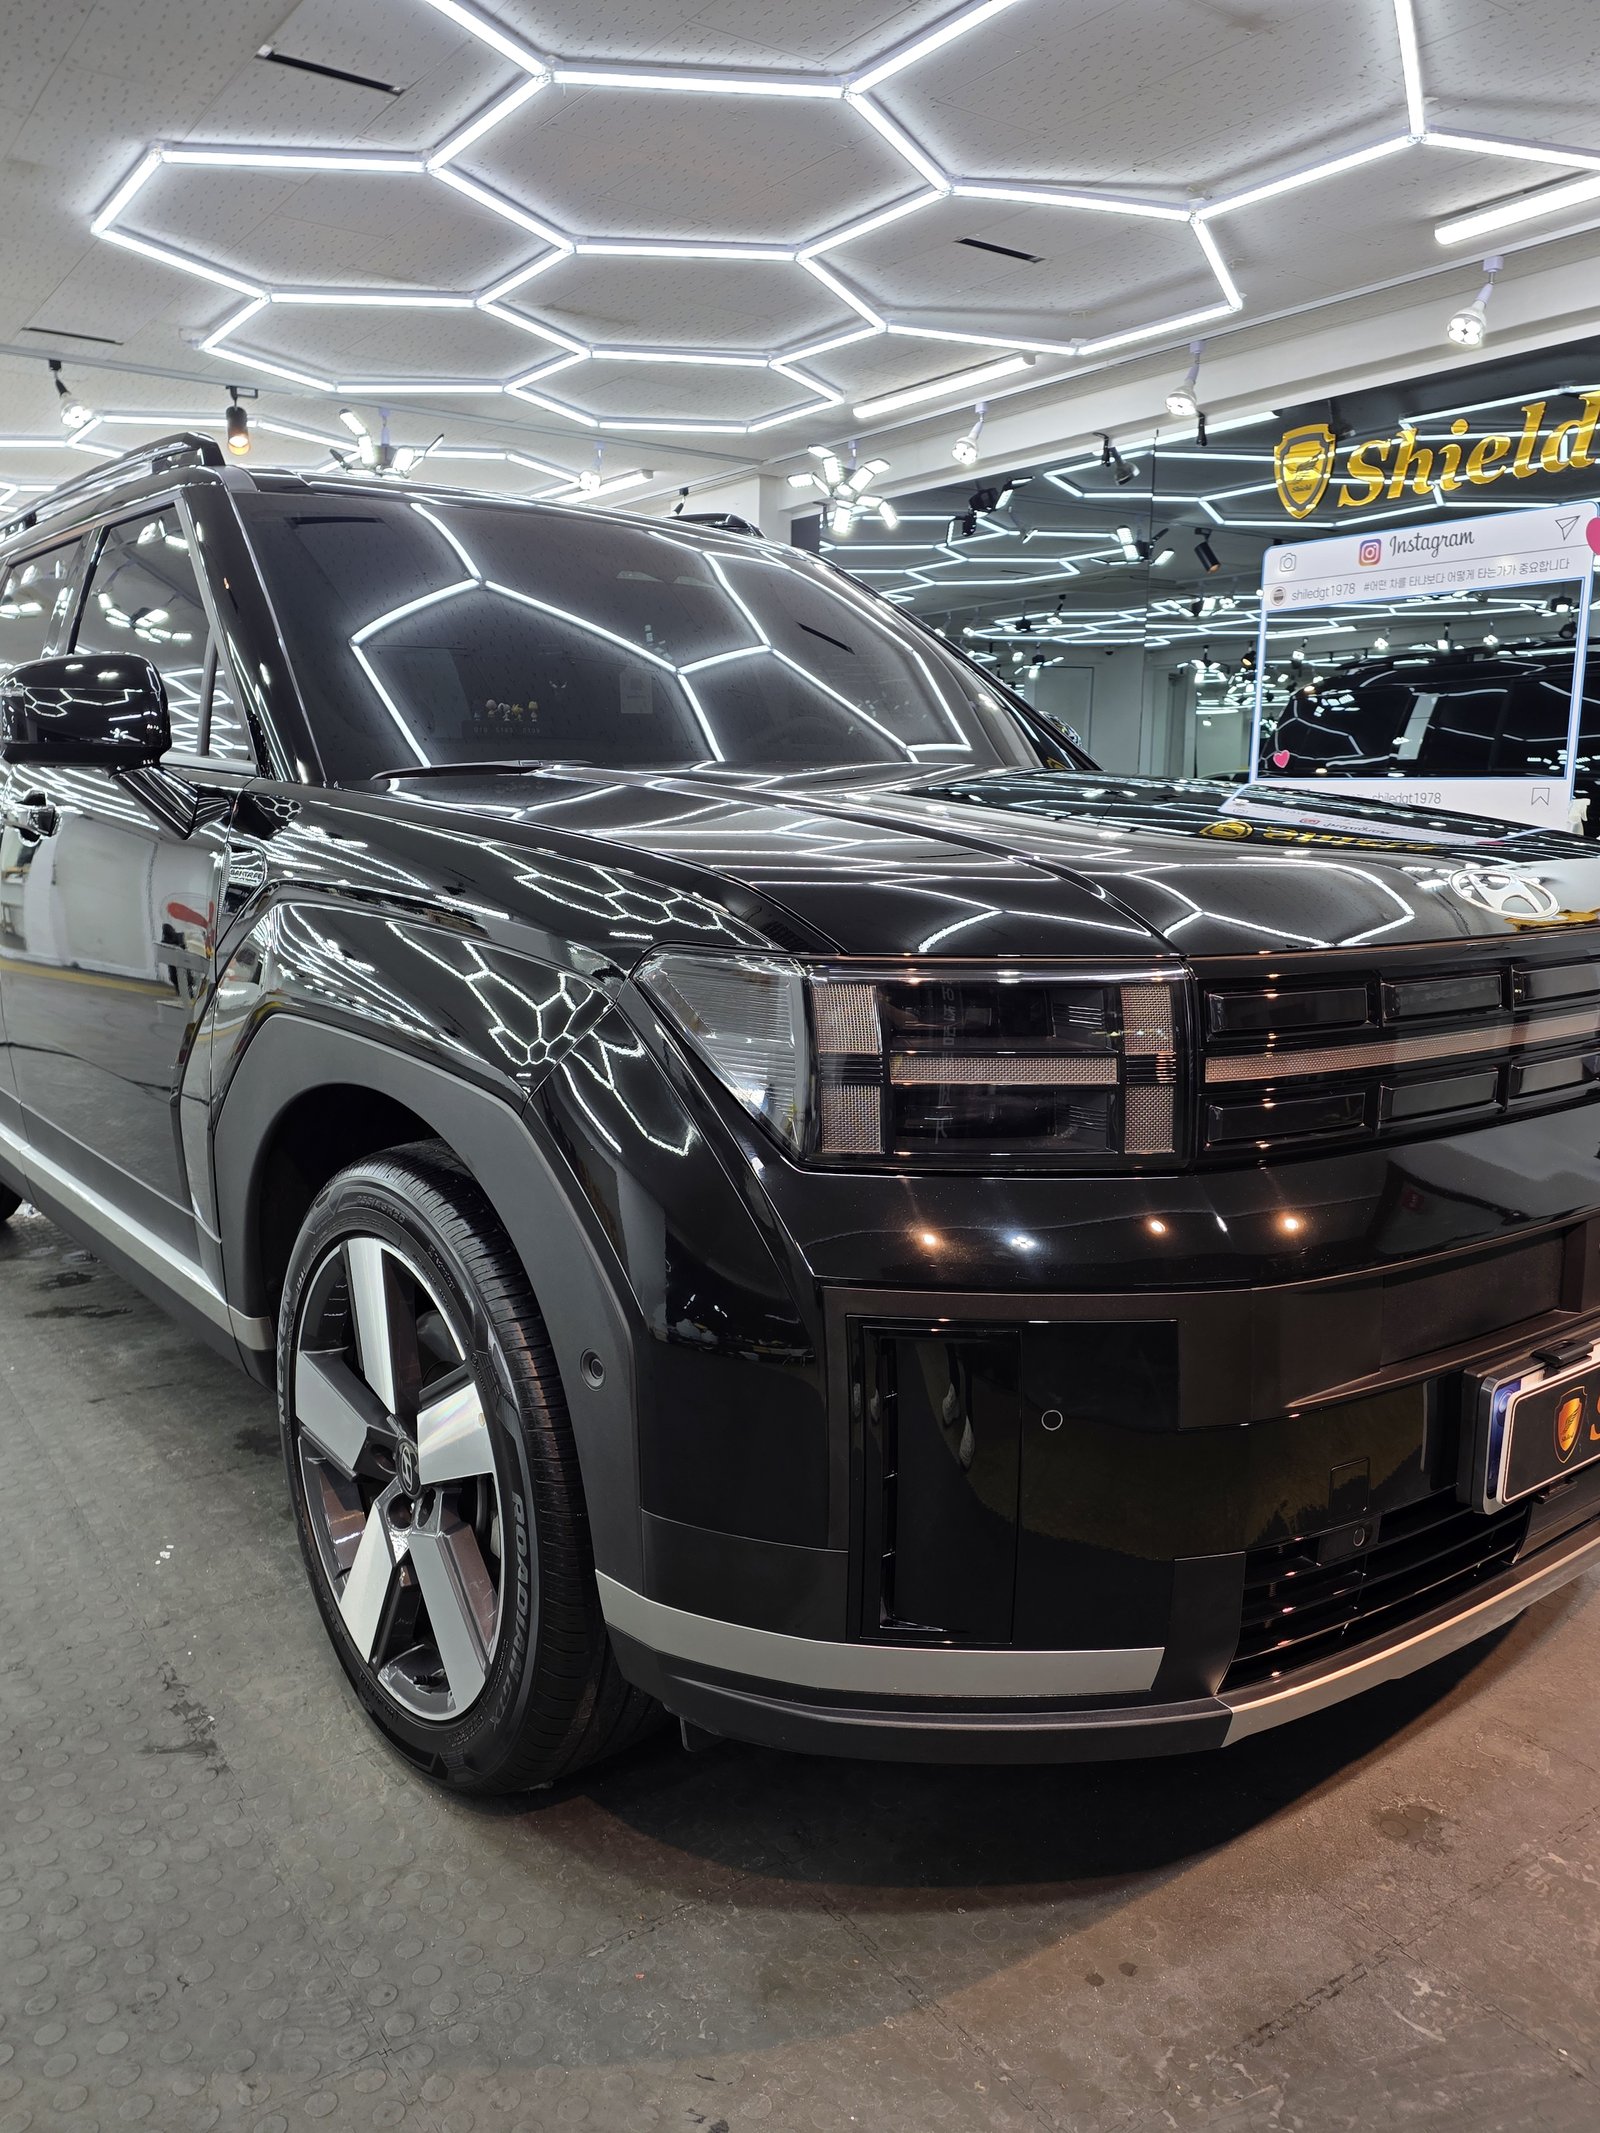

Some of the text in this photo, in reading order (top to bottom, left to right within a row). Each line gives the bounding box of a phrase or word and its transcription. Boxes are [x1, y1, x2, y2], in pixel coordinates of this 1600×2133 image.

[1337, 391, 1600, 507] Shield
[1291, 582, 1356, 600] shiledgt1978
[1519, 558, 1570, 575] 중요합니다
[1389, 531, 1475, 558] Instagram
[277, 1283, 292, 1425] NEXEN
[512, 1491, 529, 1680] ROADIAN
